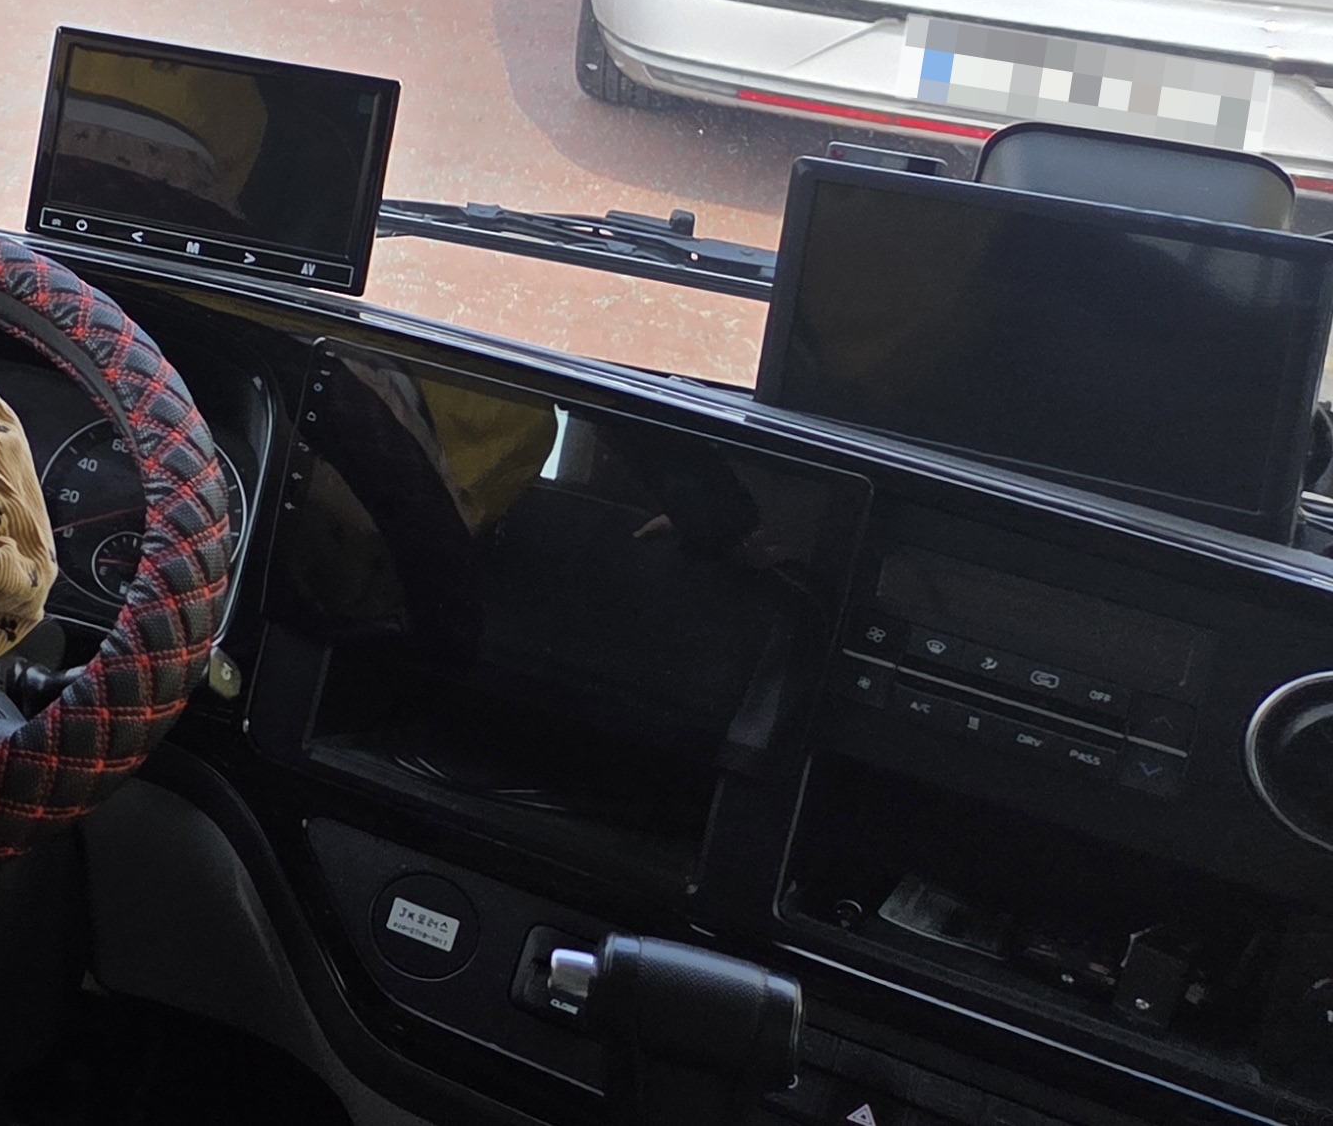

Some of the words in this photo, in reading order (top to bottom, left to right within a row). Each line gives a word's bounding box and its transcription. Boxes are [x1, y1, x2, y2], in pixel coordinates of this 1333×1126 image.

[186, 241, 200, 255] M
[301, 263, 316, 276] AV
[77, 457, 98, 473] 40
[59, 488, 80, 504] 20
[1088, 689, 1112, 703] OFF
[910, 700, 932, 714] A/C
[1069, 749, 1101, 766] PASS
